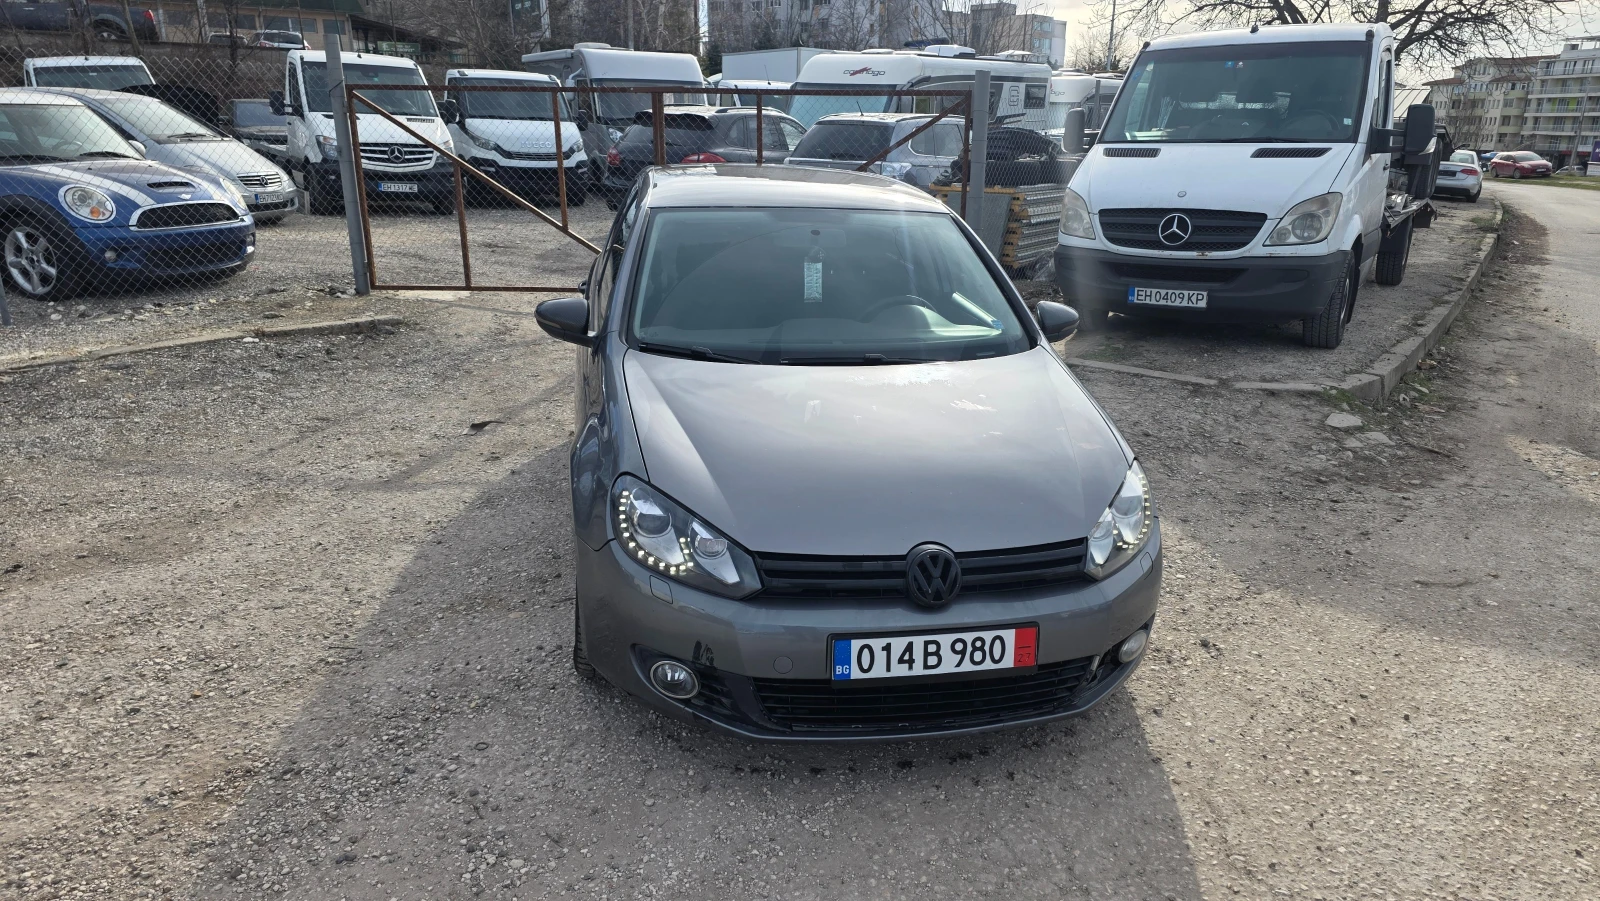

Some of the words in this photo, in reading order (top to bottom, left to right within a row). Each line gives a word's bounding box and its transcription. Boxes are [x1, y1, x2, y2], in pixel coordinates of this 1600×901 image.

[1136, 289, 1153, 302] EH
[1154, 290, 1185, 304] 0409
[1187, 292, 1205, 305] KP
[835, 665, 850, 675] BG
